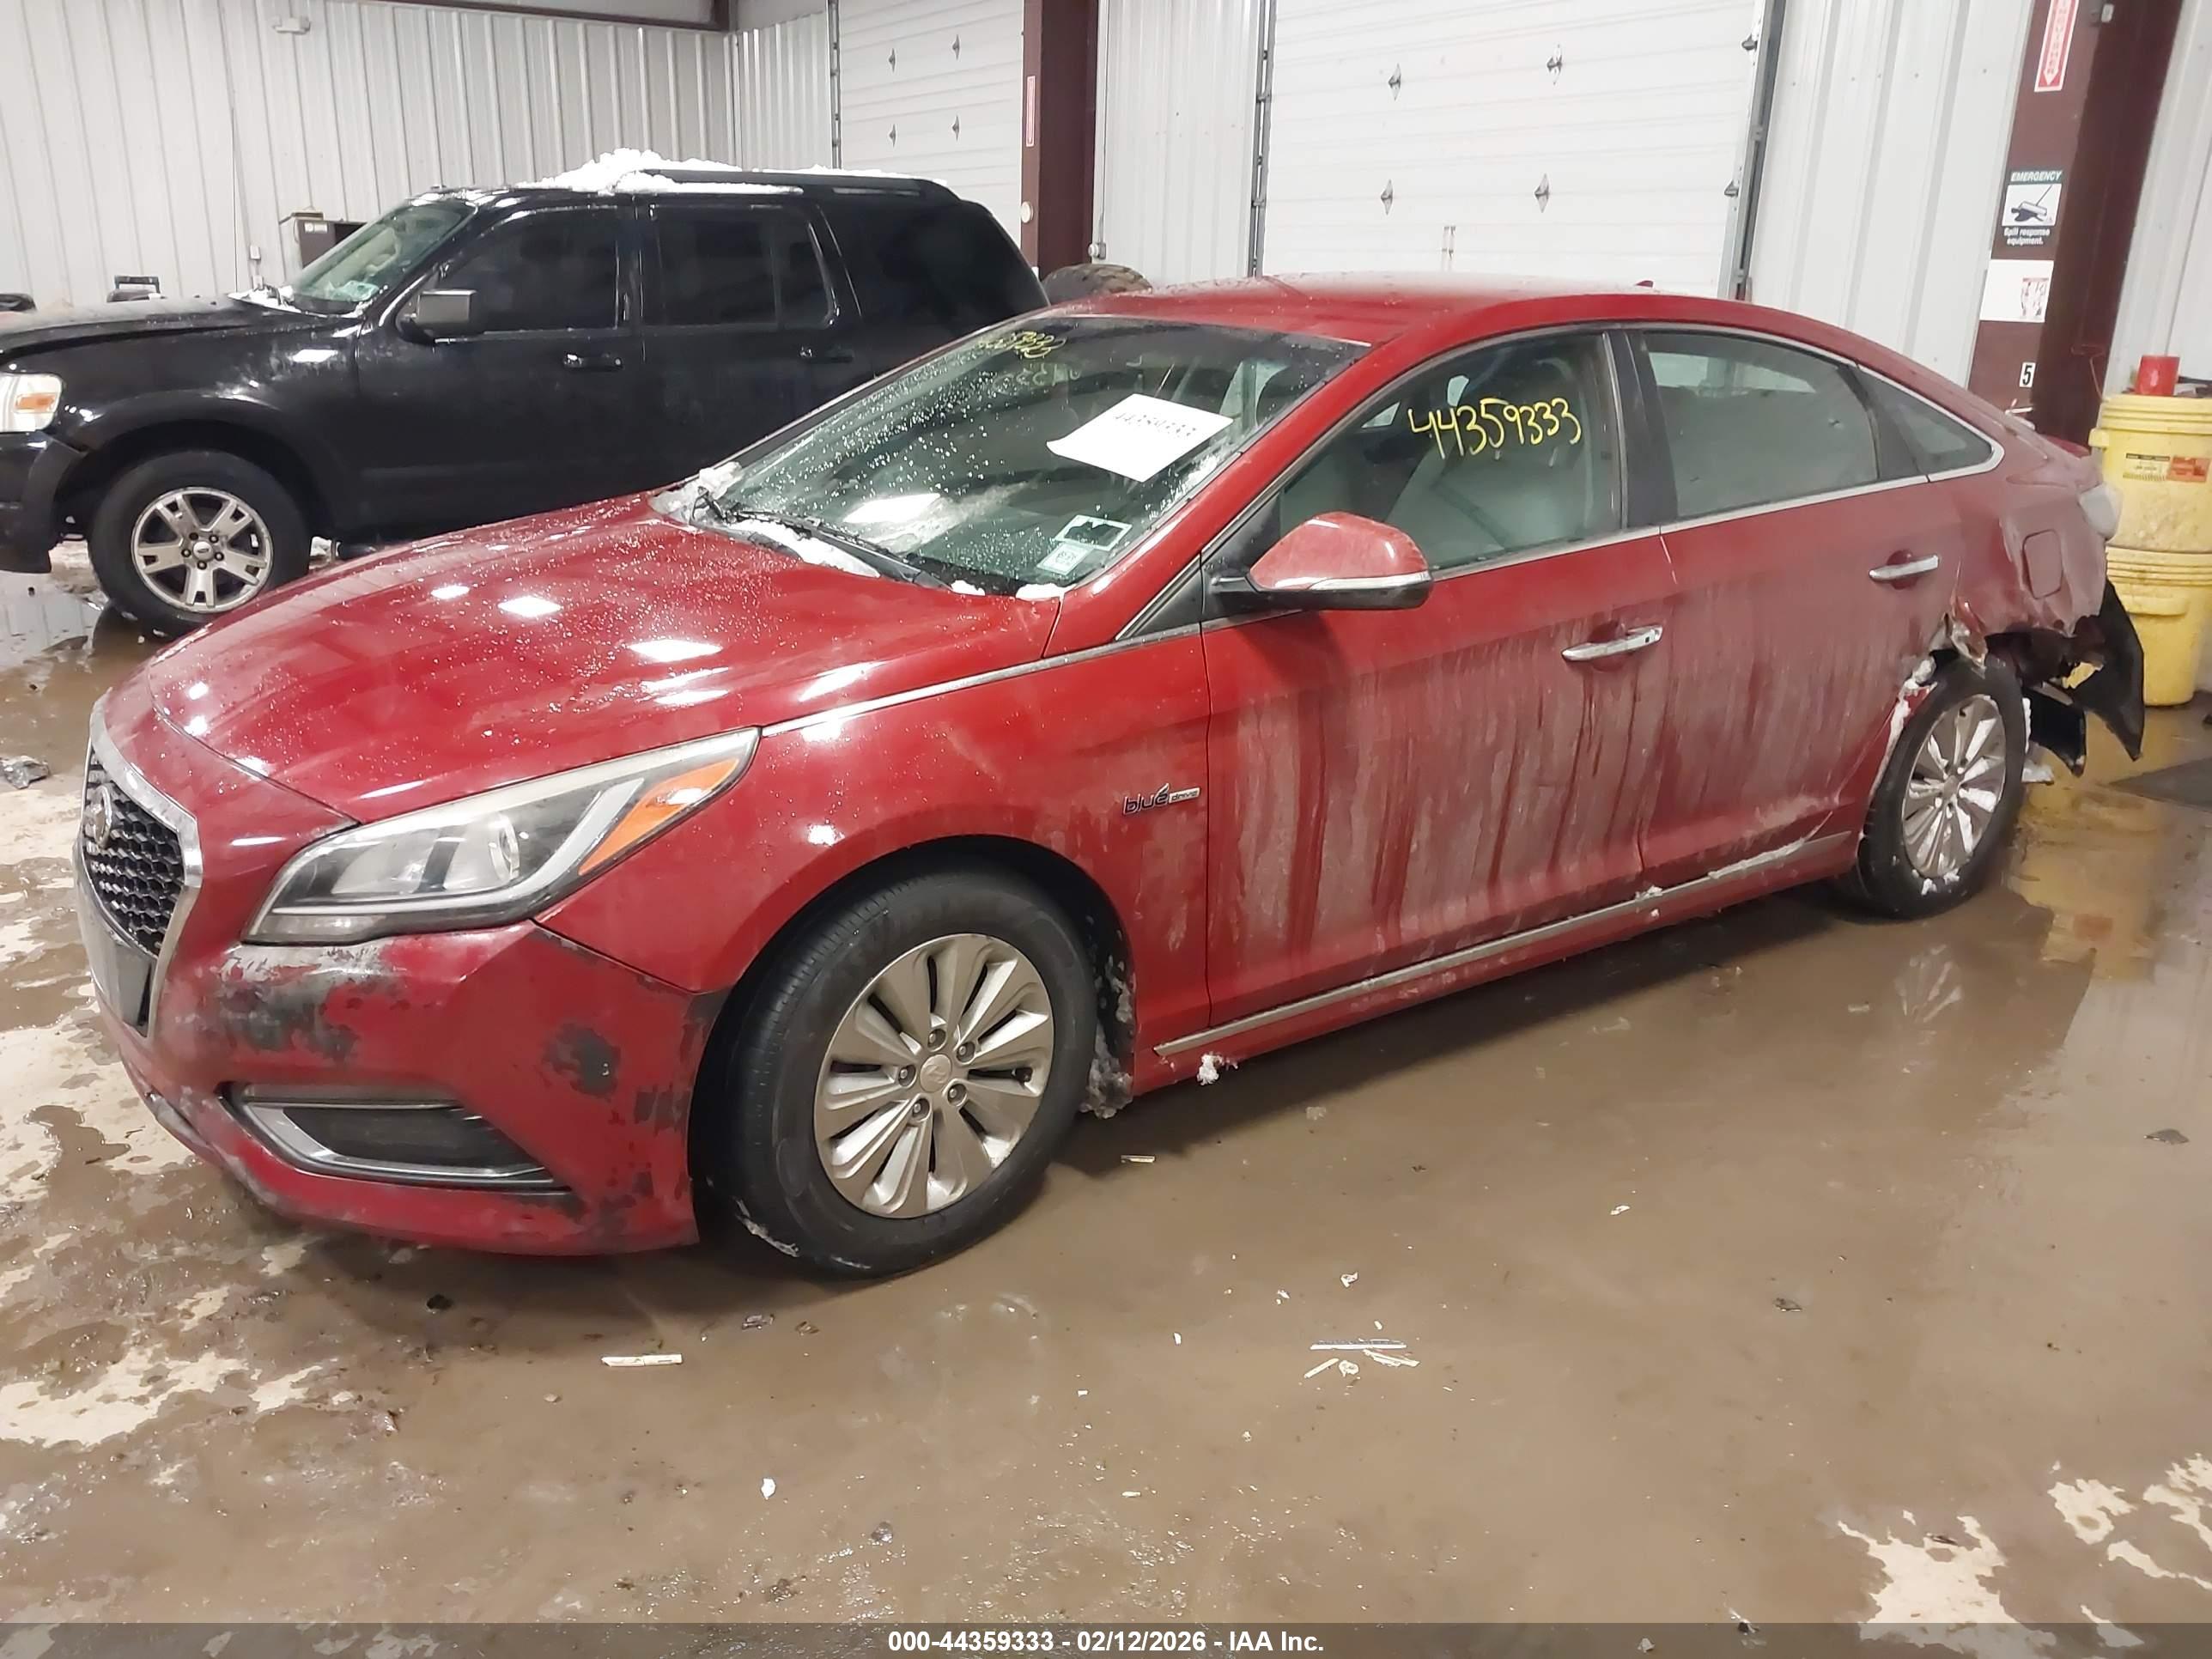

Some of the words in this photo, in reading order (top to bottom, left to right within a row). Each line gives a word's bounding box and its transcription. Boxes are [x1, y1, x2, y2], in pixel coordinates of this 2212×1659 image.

[2010, 170, 2063, 182] EMERGENCY
[2004, 227, 2019, 236] Spill
[2020, 228, 2051, 236] response
[2022, 364, 2033, 386] 5
[1407, 397, 1582, 460] 44359333
[1122, 783, 1170, 815] blue
[1171, 790, 1199, 801] drive
